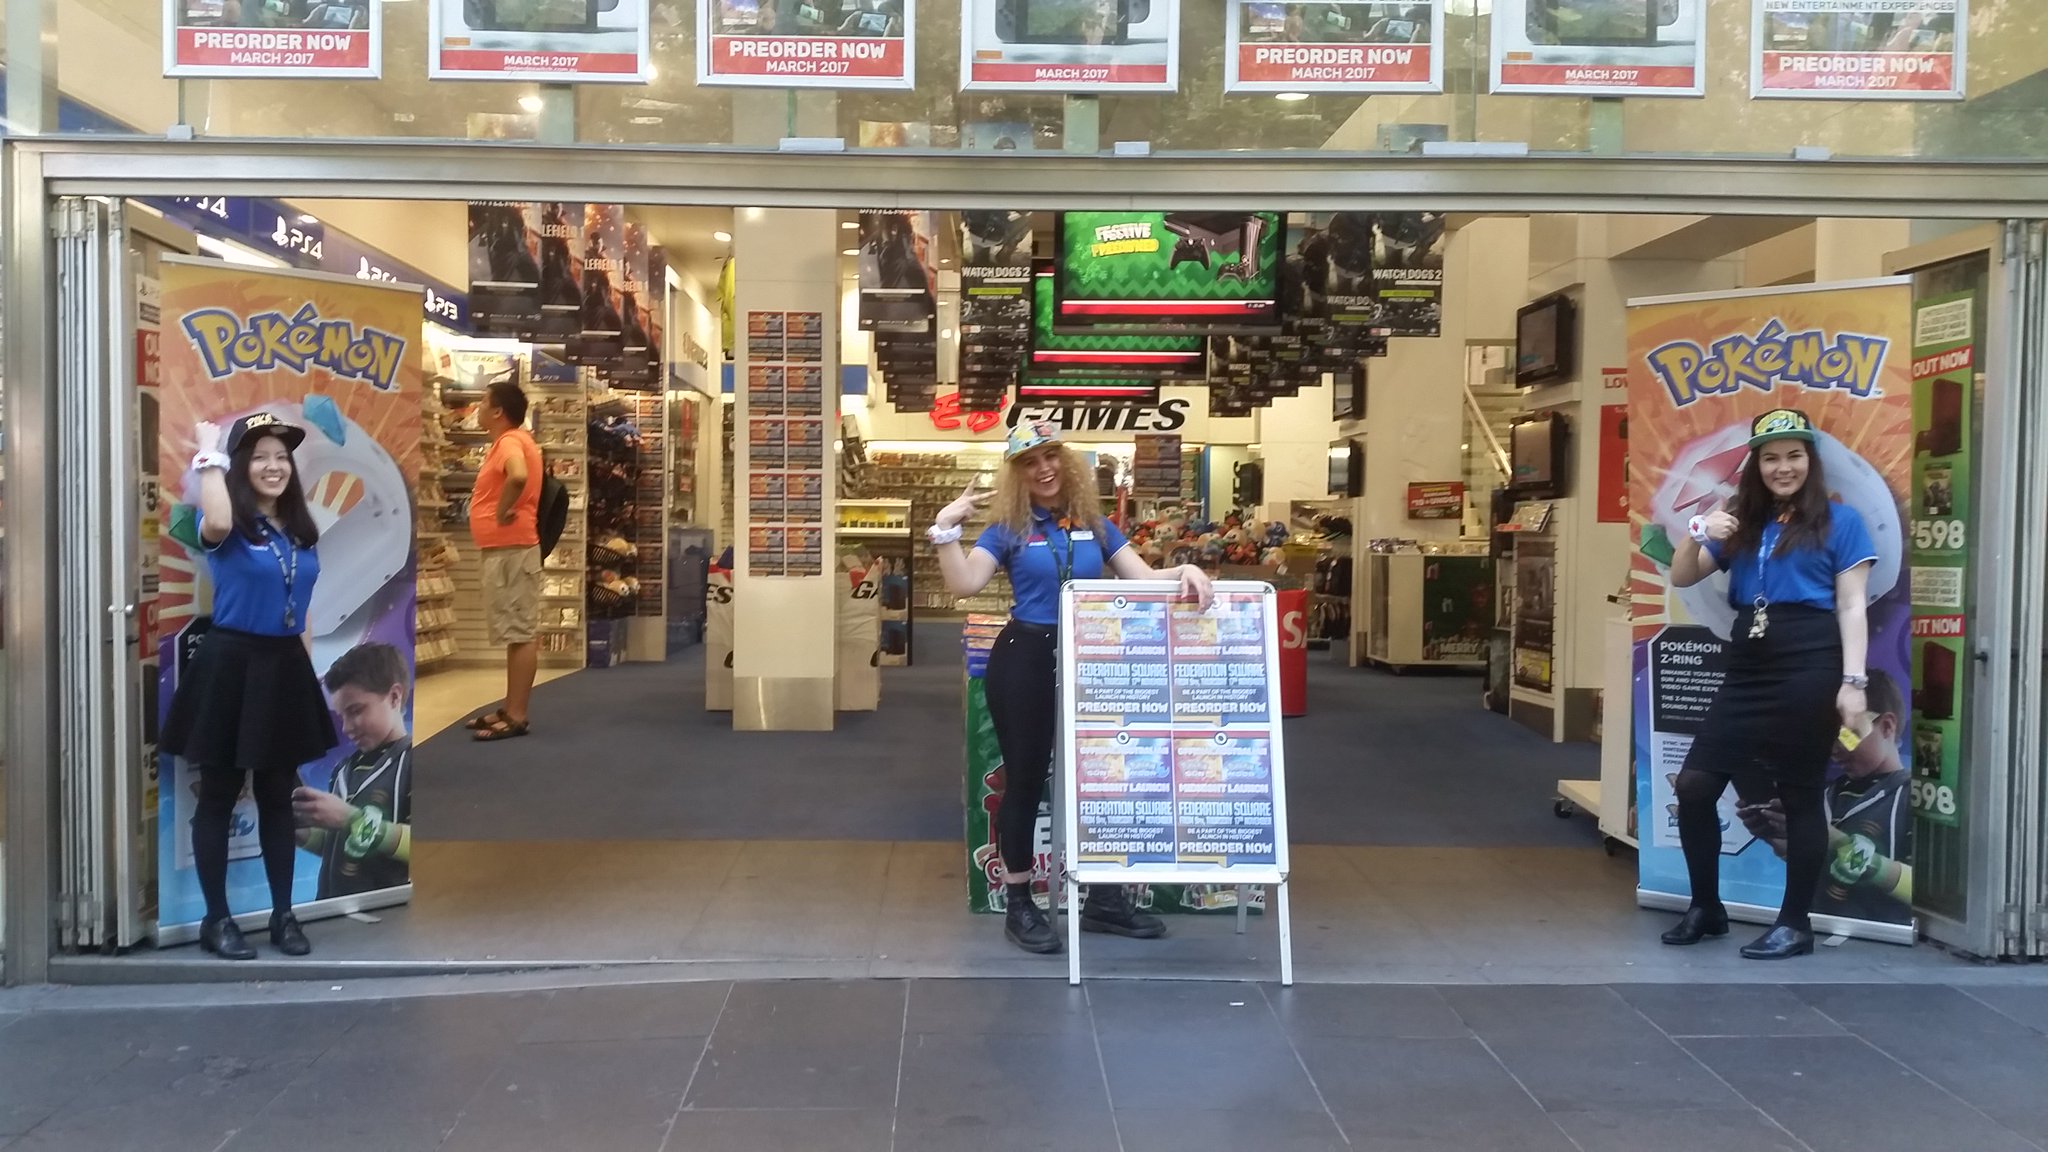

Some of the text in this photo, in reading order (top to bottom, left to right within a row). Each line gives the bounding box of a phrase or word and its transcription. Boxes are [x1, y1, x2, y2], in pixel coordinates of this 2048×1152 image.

[1766, 1, 1789, 9] NEW
[1881, 1, 1955, 10] EXPERENCES
[194, 32, 351, 50] PREORDER NOW
[729, 41, 886, 58] PREORDER NOW
[230, 51, 315, 64] MARCH 2017
[504, 55, 579, 67] MARCH 2017
[1255, 48, 1412, 65] PREORDER NOW
[766, 60, 850, 73] MARCH 2017
[1779, 56, 1935, 73] PREORDER NOW
[1035, 68, 1109, 79] MARCH 2017
[1291, 67, 1376, 79] MARCH 2017
[1565, 69, 1639, 80] MARCH 2017
[1814, 75, 1898, 87] MARCH 2017
[290, 228, 324, 260] PS4
[1022, 267, 1031, 277] 2
[1434, 269, 1443, 279] 2
[434, 296, 458, 320] PS3
[1912, 347, 1971, 377] OUT NOW
[851, 581, 881, 599] GA
[1931, 618, 1961, 635] NOW
[1660, 640, 1722, 654] POKÉMON
[1660, 654, 1703, 665] Z-RING
[1078, 662, 1168, 677] FEDERATION SQUARE
[1173, 663, 1266, 677] FEDERATION SQUARE
[1077, 701, 1169, 713] PREORDER NOW
[1174, 702, 1267, 713] PREORDER NOW
[1911, 780, 1957, 815] 598
[1080, 801, 1173, 815] FEDERATION SQUARE
[1178, 801, 1272, 816] FEDERATION SQUARE
[1080, 841, 1174, 853] PREORDER NOW
[1180, 842, 1273, 853] PREORDER NOW
